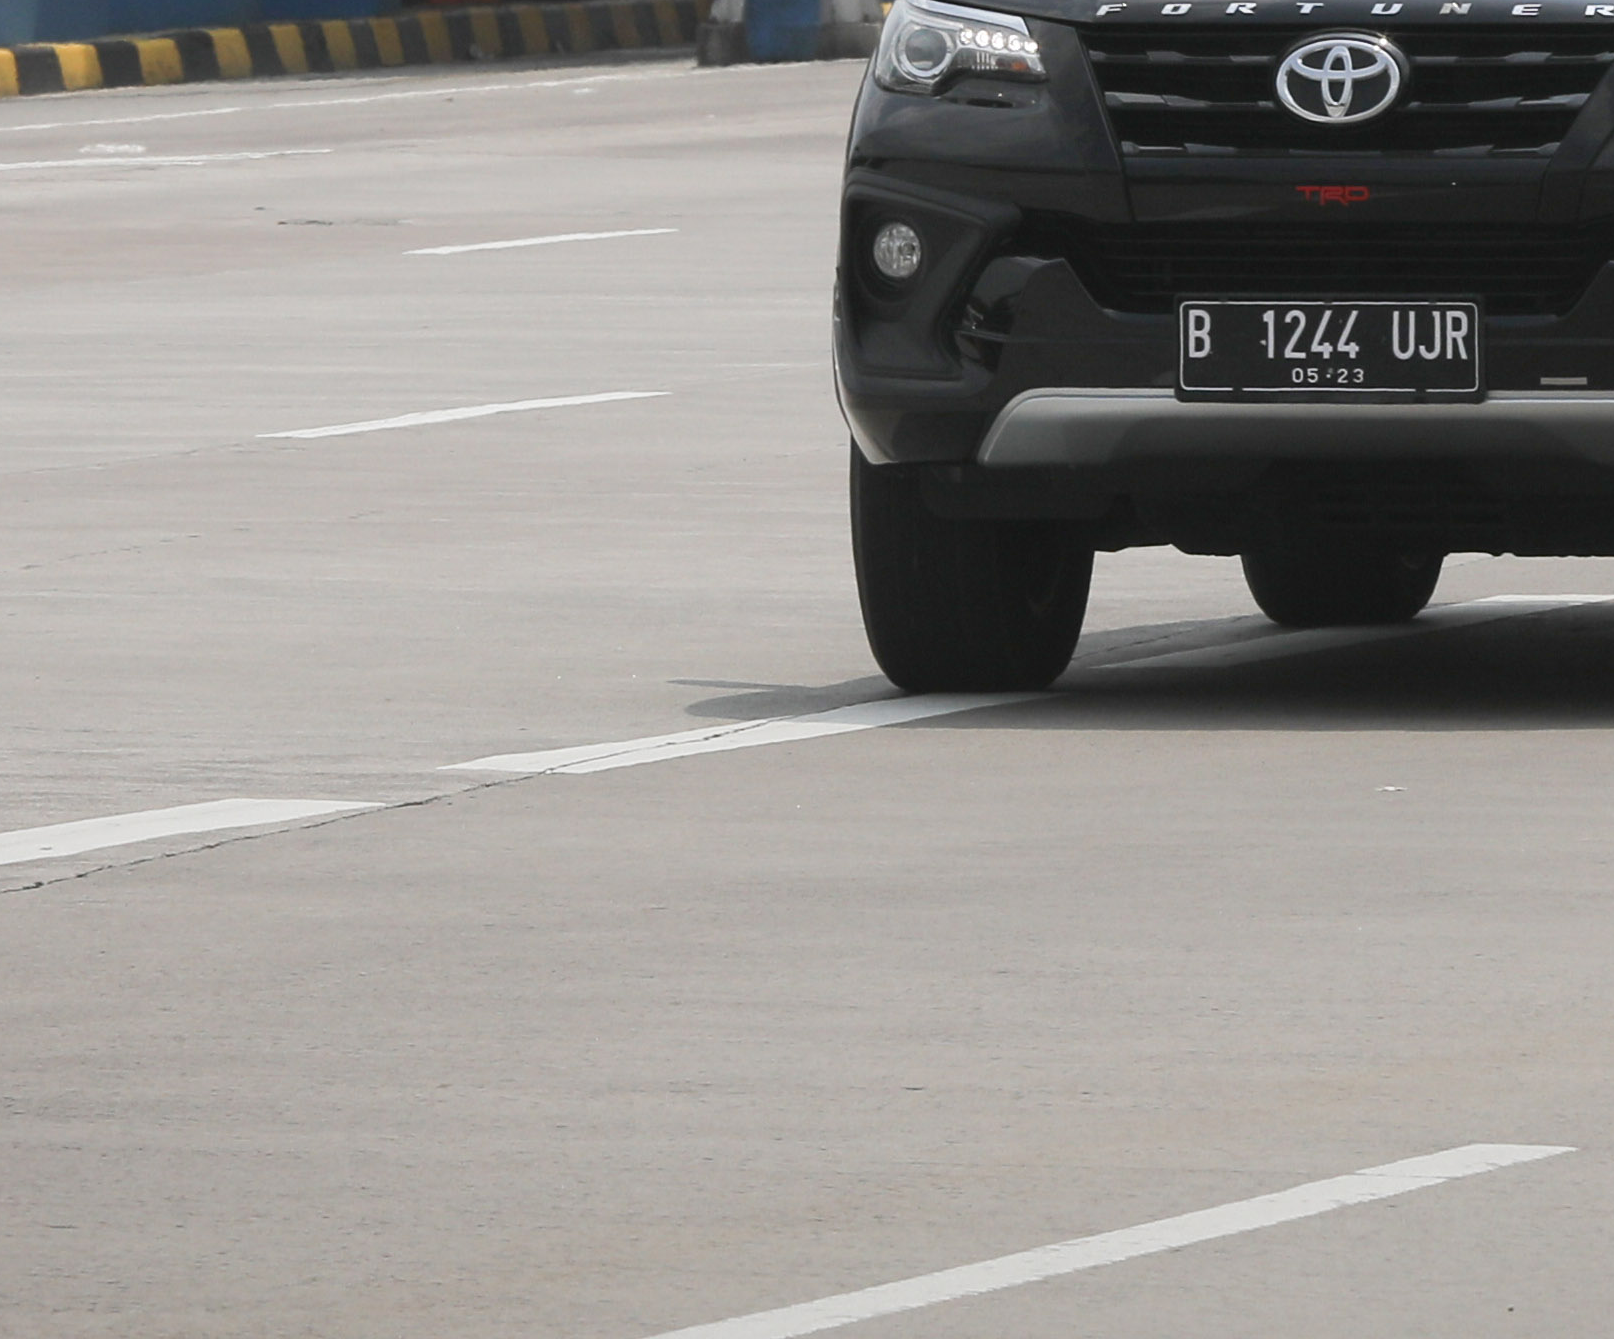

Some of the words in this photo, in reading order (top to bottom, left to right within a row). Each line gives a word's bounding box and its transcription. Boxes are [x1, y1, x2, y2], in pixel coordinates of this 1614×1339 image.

[1295, 185, 1371, 206] TRD
[1187, 308, 1212, 359] B
[1262, 309, 1360, 359] 1244
[1391, 309, 1470, 360] UJR
